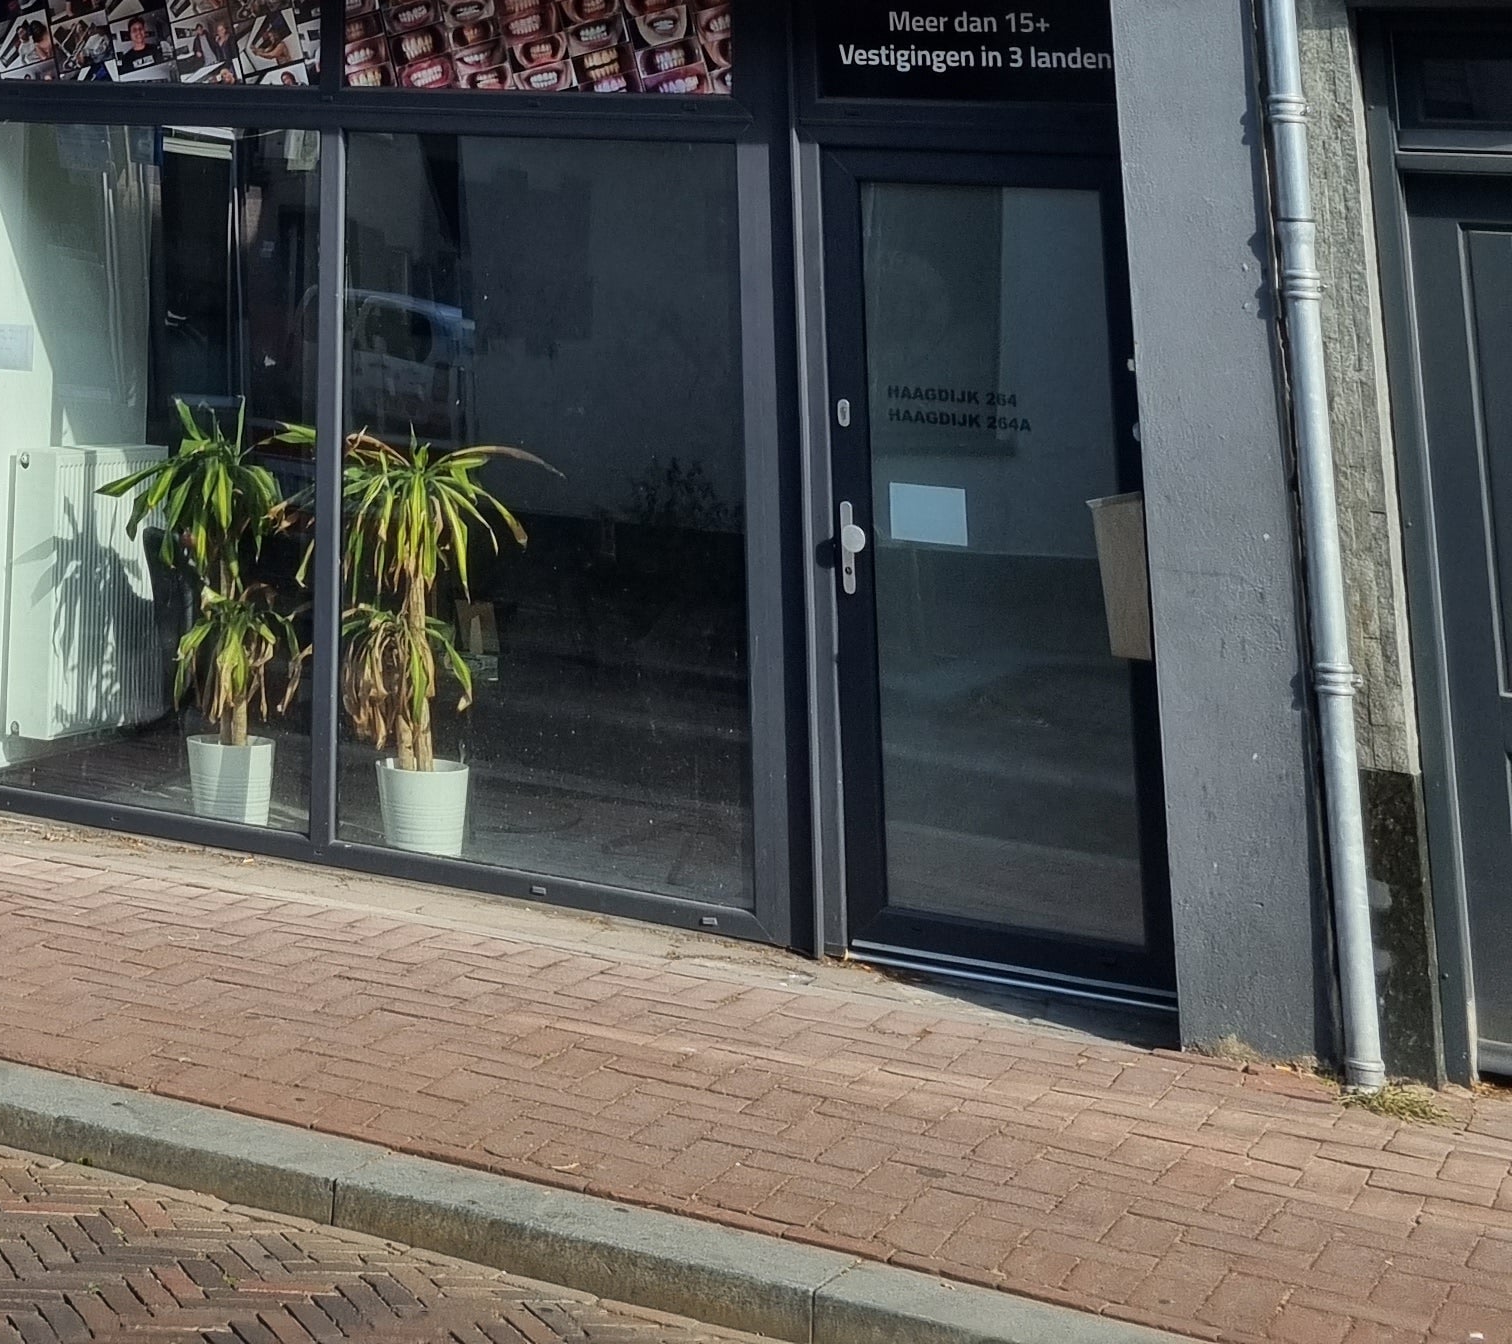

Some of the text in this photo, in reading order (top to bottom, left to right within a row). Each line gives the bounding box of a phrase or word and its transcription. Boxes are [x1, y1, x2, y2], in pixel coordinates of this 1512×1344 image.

[888, 11, 1050, 33] Meer dan 15+
[838, 44, 1112, 72] Vestigingen in 3 landen
[888, 385, 1017, 407] HAAGDIJK 264
[889, 408, 1031, 431] HAAGDIJK 264A
